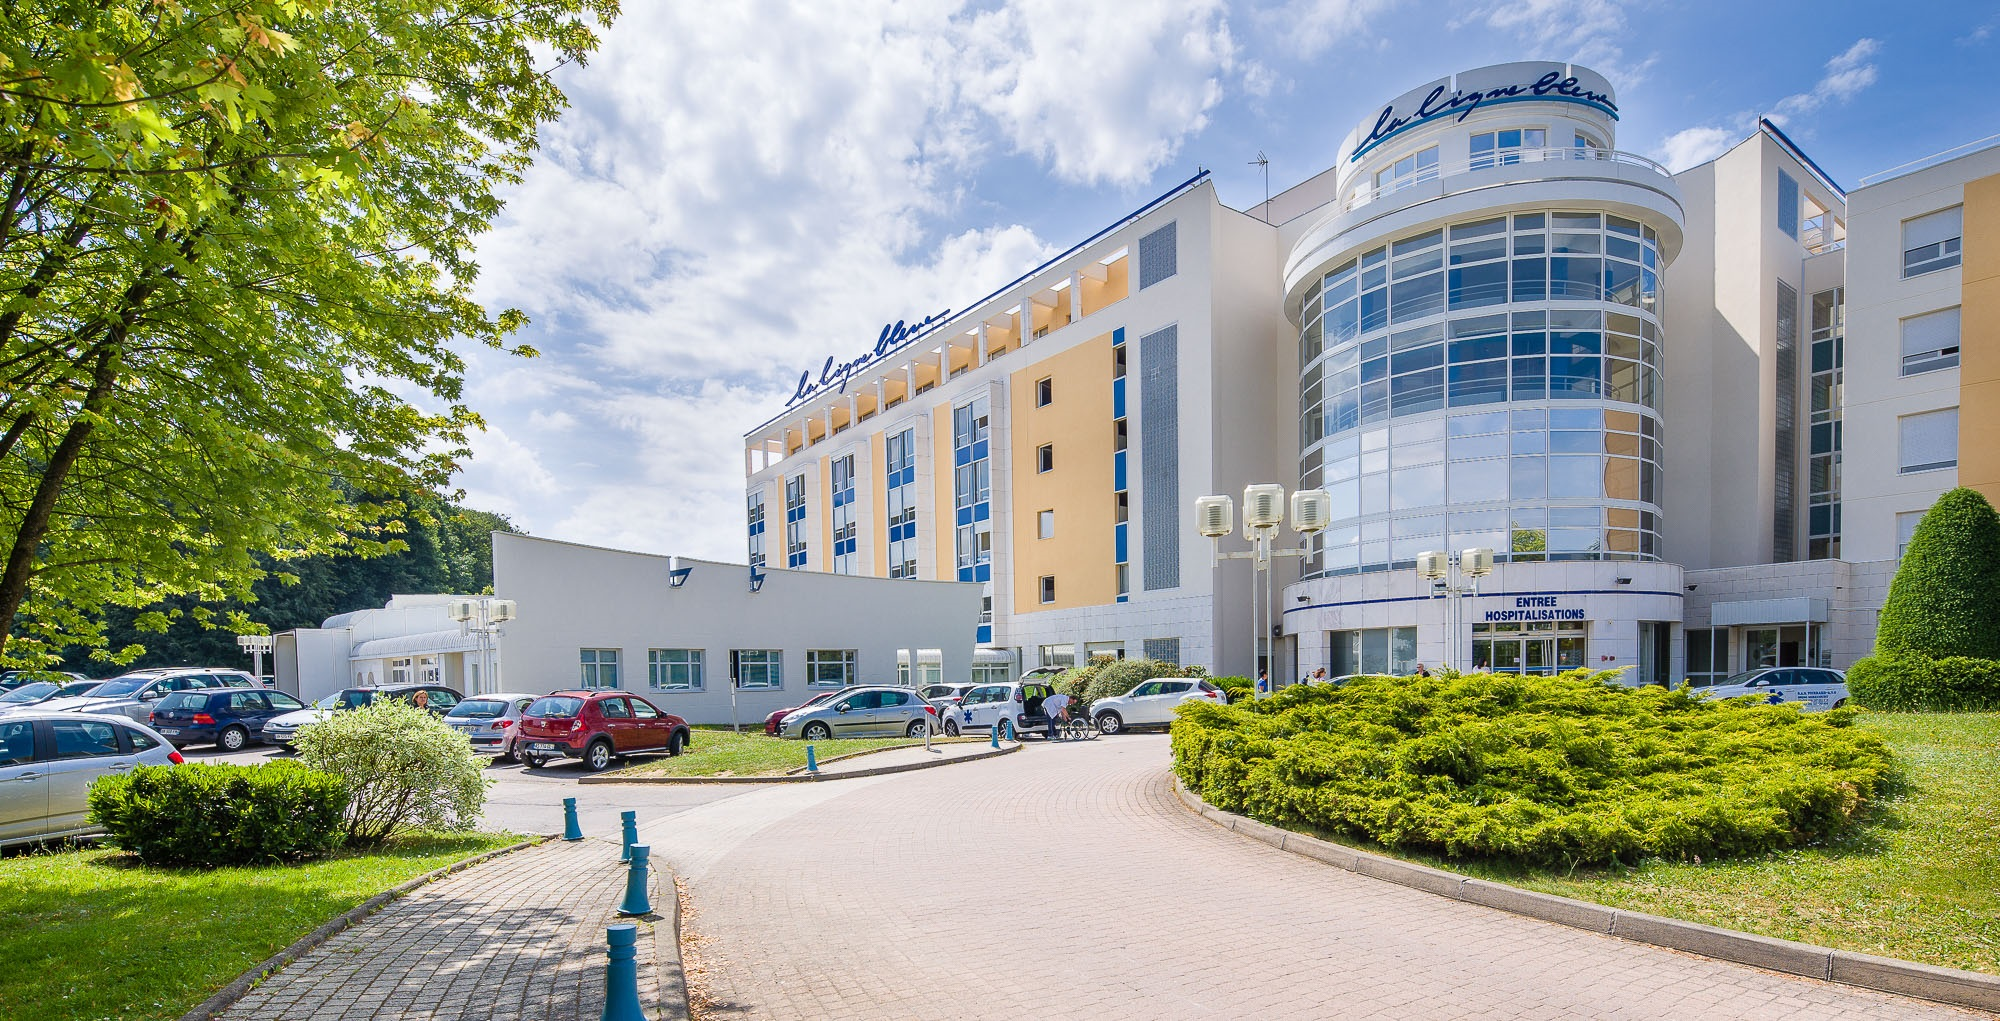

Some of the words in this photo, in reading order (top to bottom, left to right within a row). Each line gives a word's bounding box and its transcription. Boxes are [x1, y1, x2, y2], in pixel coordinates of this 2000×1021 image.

[1352, 105, 1412, 156] la
[1413, 85, 1528, 123] ligne
[1529, 71, 1619, 112] bleue
[785, 370, 819, 407] la
[818, 353, 873, 394] ligne
[873, 309, 951, 357] bleue
[1485, 609, 1585, 621] HOSPITALISATIONS
[1516, 596, 1557, 607] ENTREE
